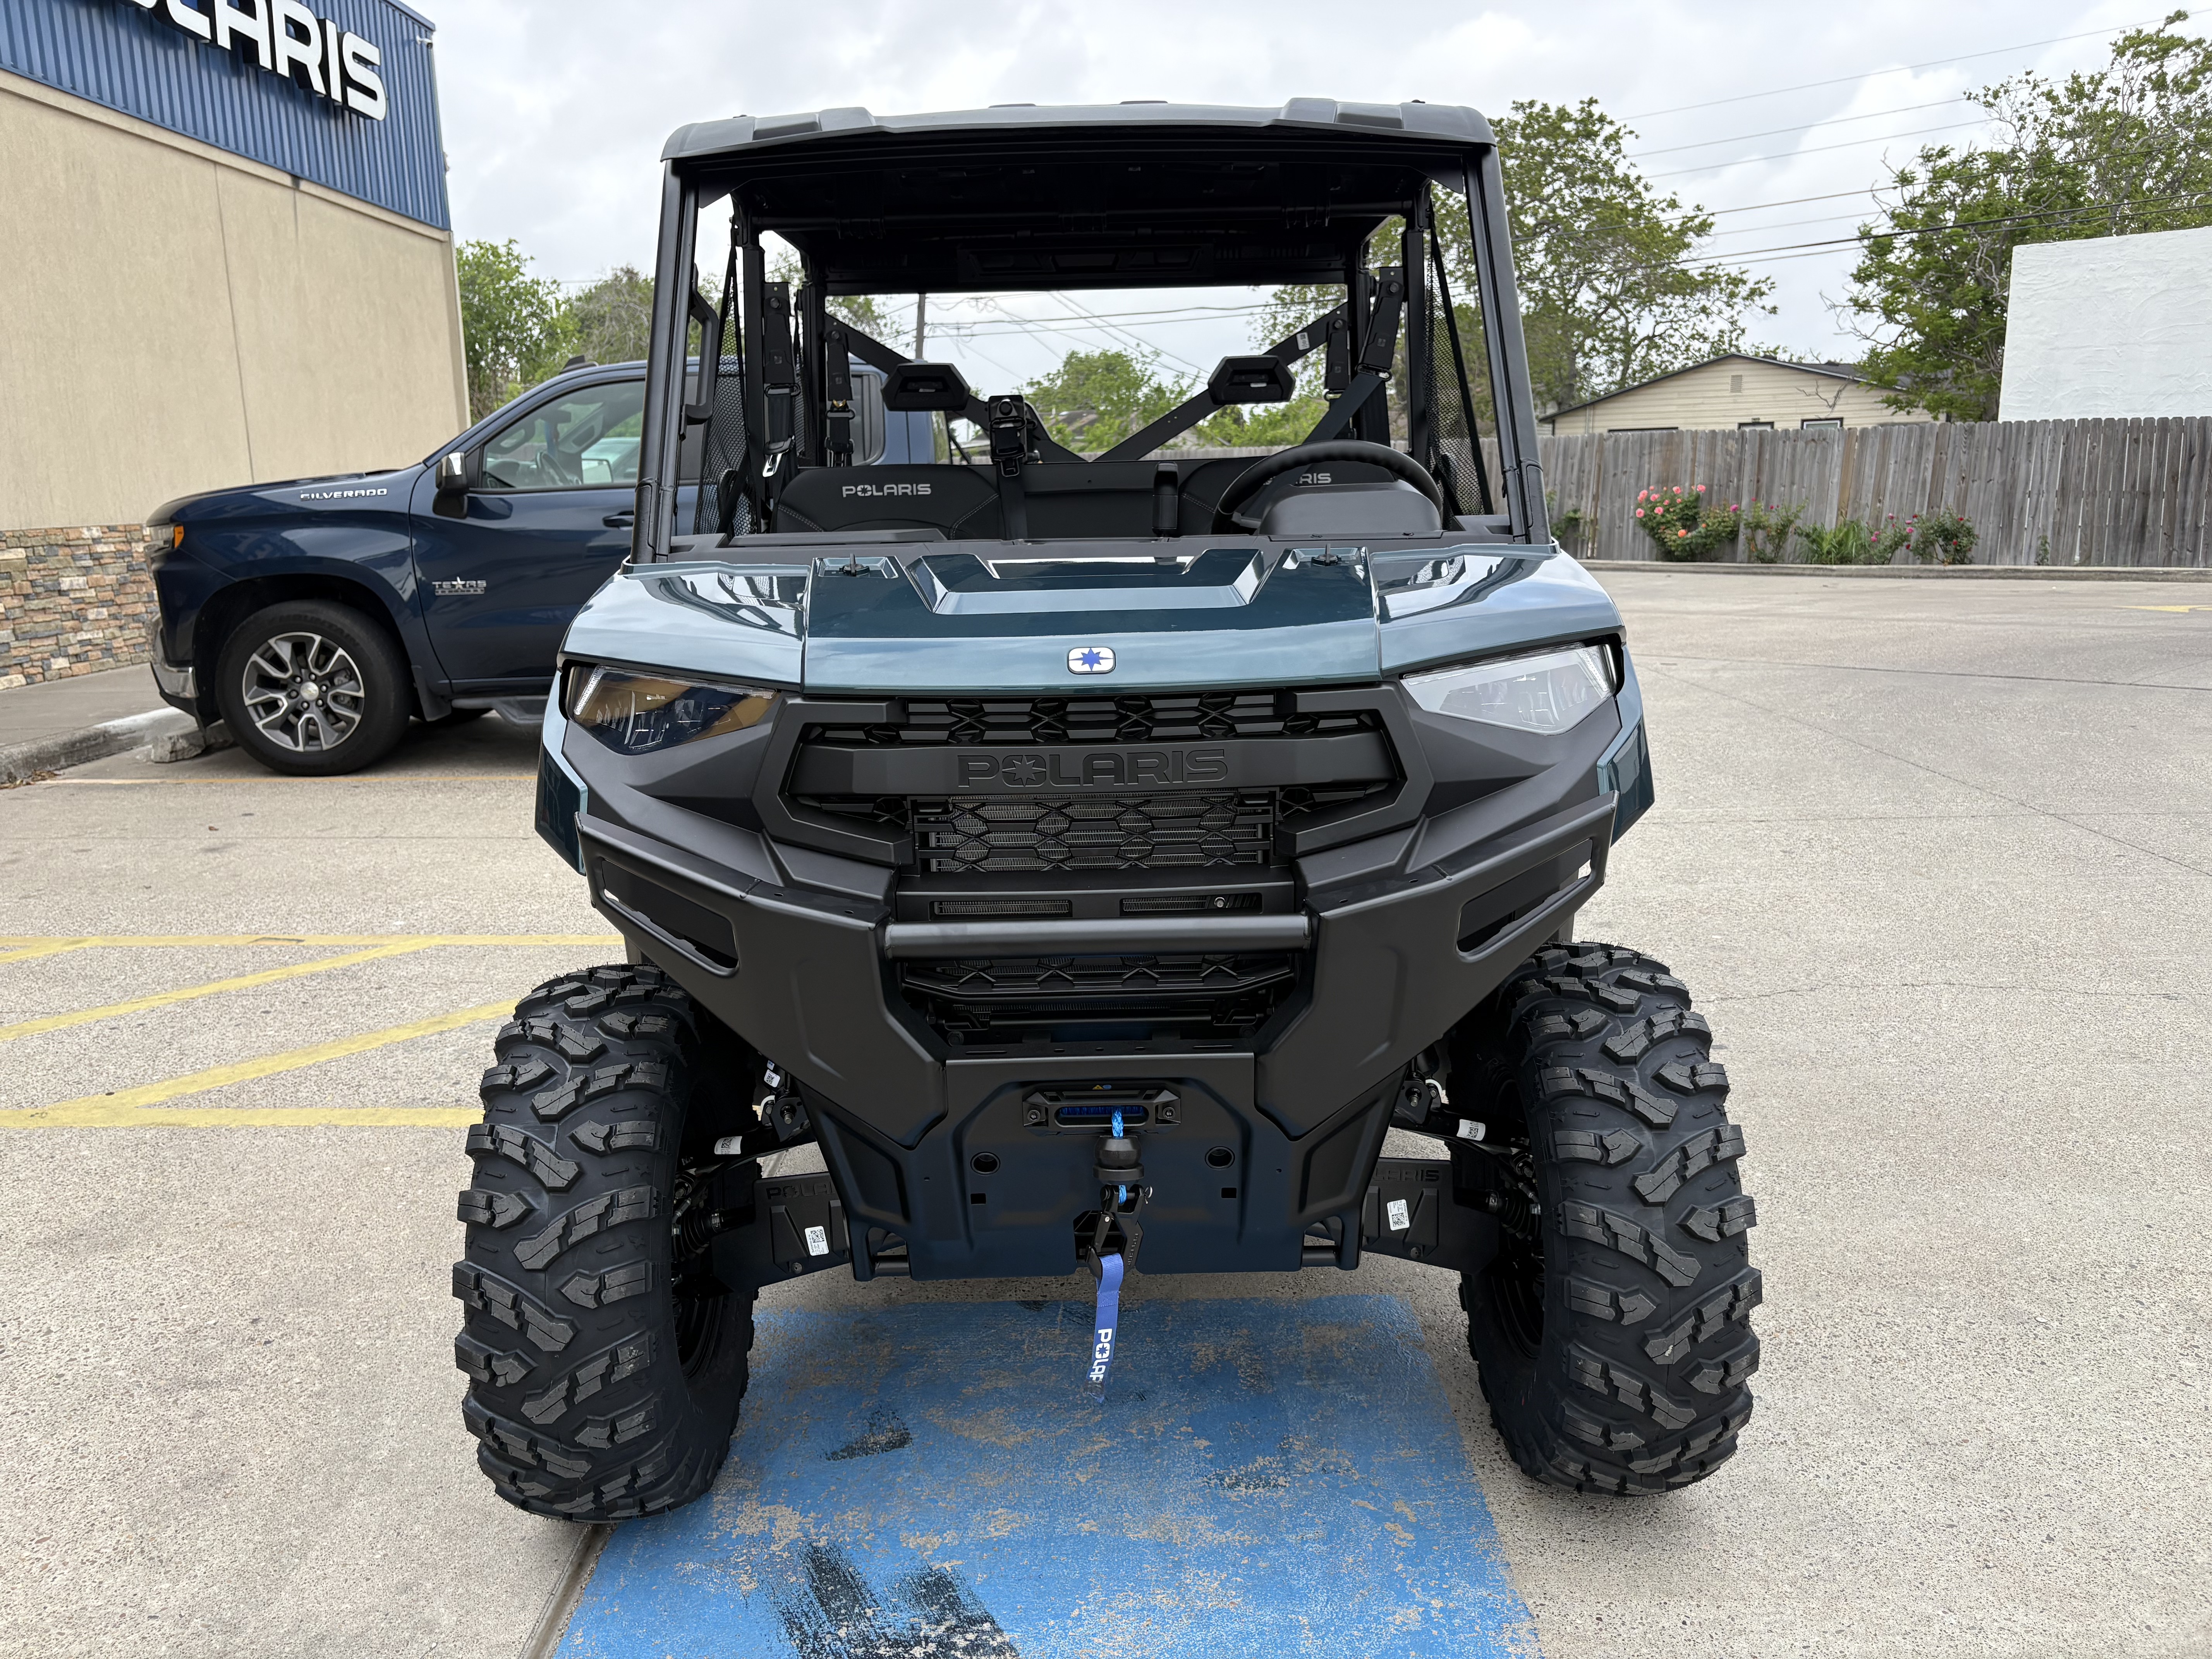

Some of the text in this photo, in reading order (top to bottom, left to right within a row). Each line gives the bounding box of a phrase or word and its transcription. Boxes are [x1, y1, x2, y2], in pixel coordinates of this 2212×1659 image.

[301, 488, 387, 501] SILVERADO
[842, 484, 931, 497] POLARIS
[957, 749, 1227, 787] POLARIS
